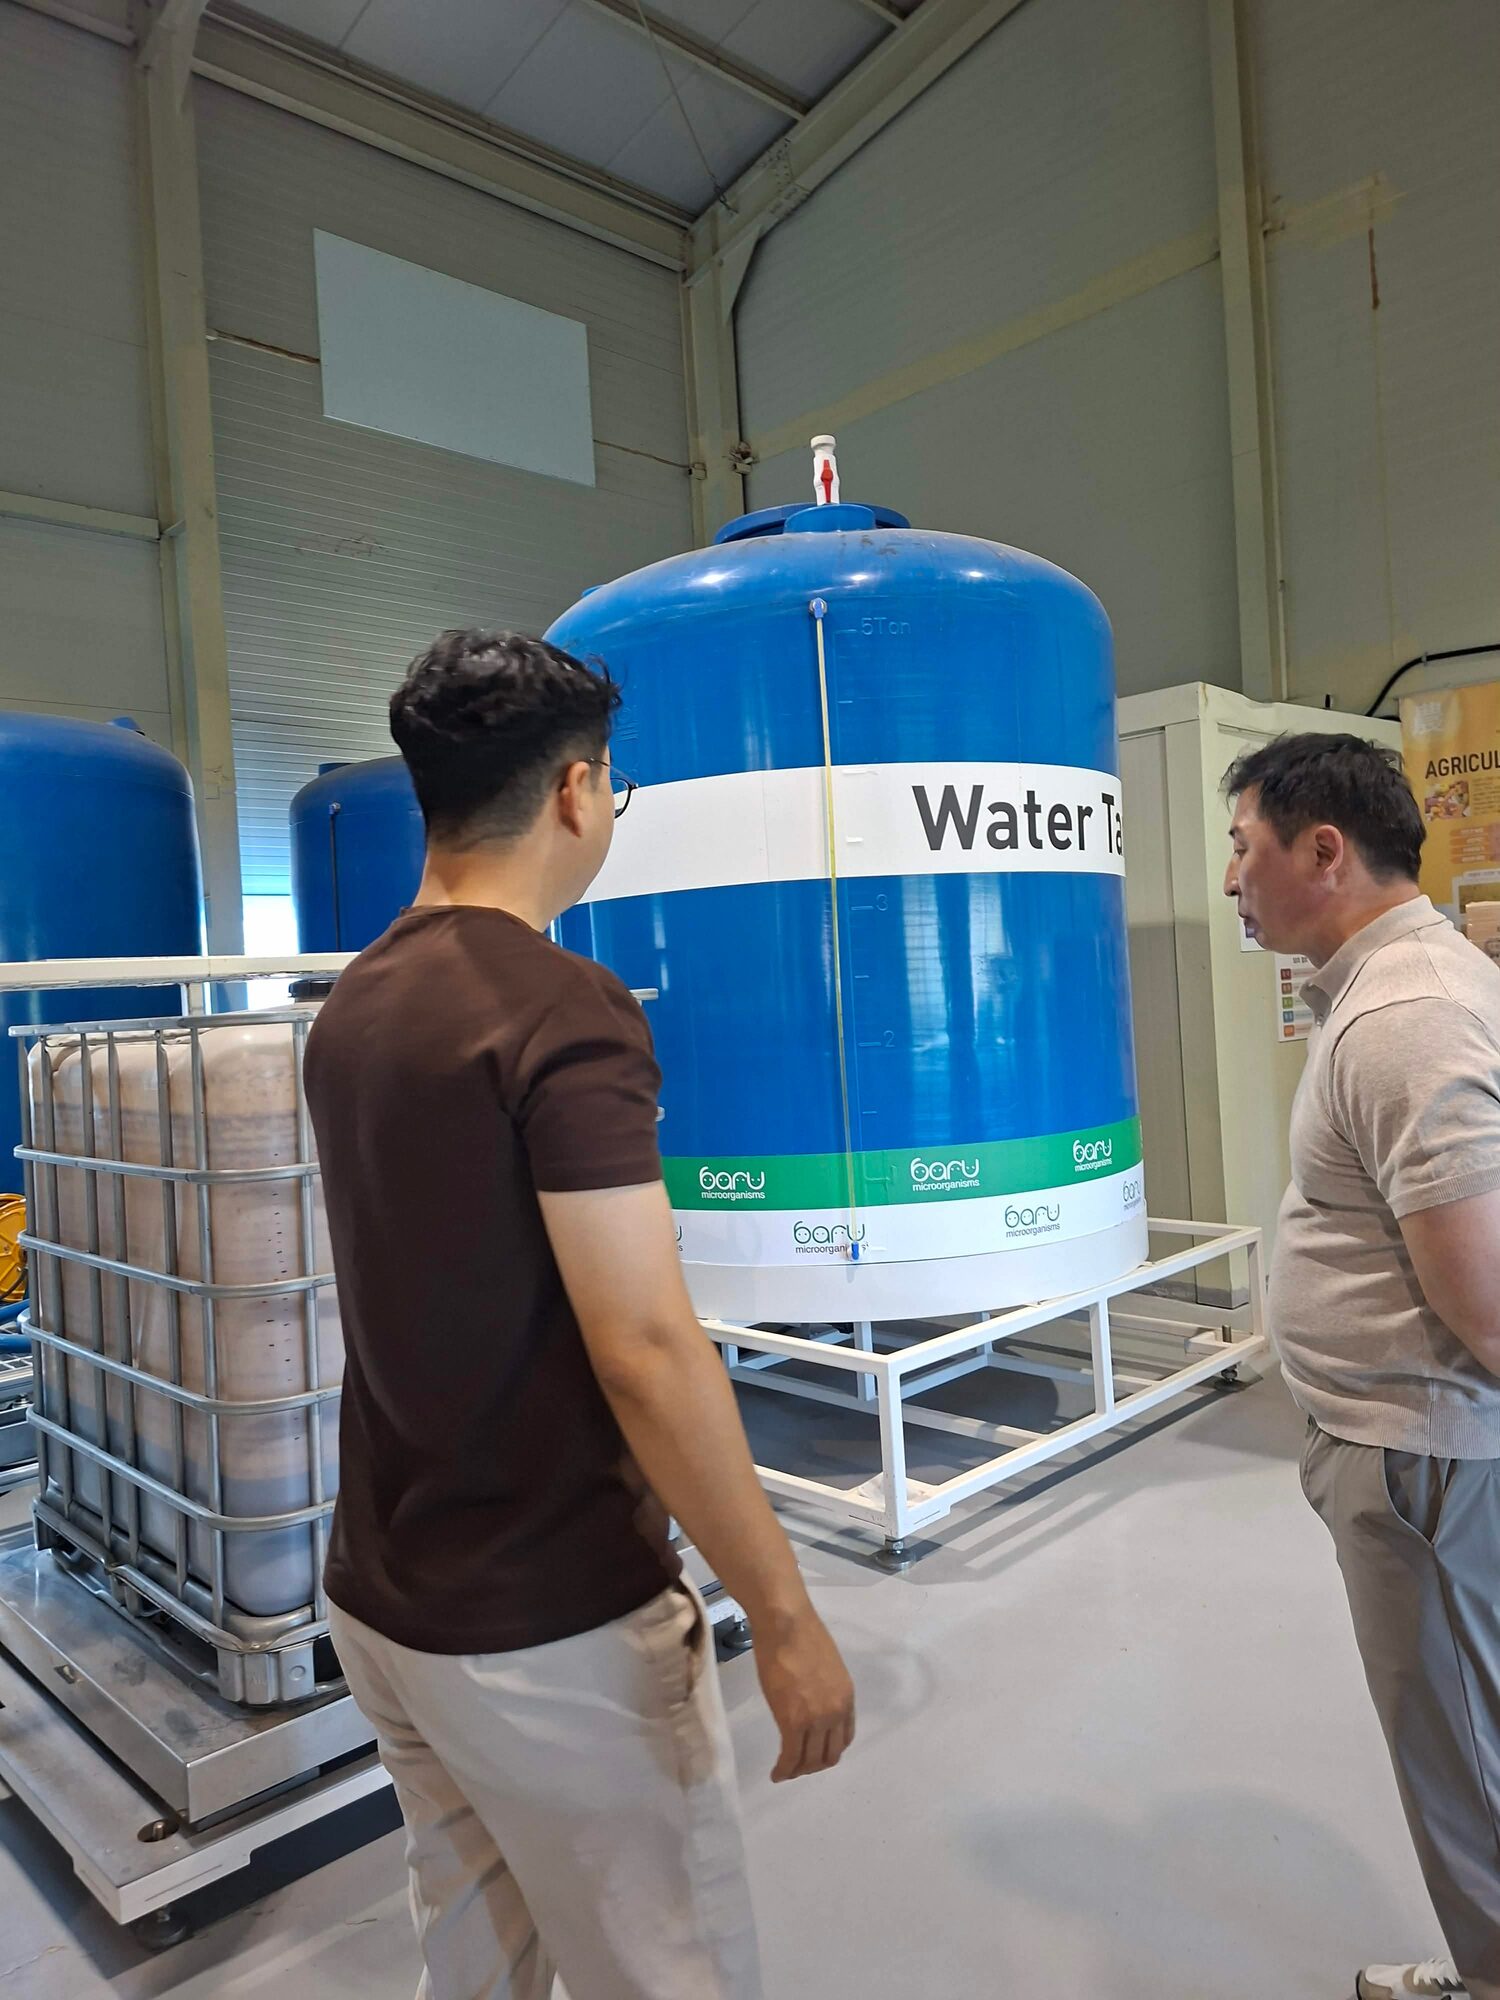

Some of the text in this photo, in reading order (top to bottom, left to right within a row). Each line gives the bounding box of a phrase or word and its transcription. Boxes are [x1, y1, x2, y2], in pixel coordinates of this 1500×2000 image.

[911, 784, 1094, 851] Water
[883, 1030, 895, 1048] 2
[912, 1179, 980, 1191] microorganisms
[701, 1190, 766, 1201] microorganisms
[1005, 1223, 1061, 1238] microorganisms
